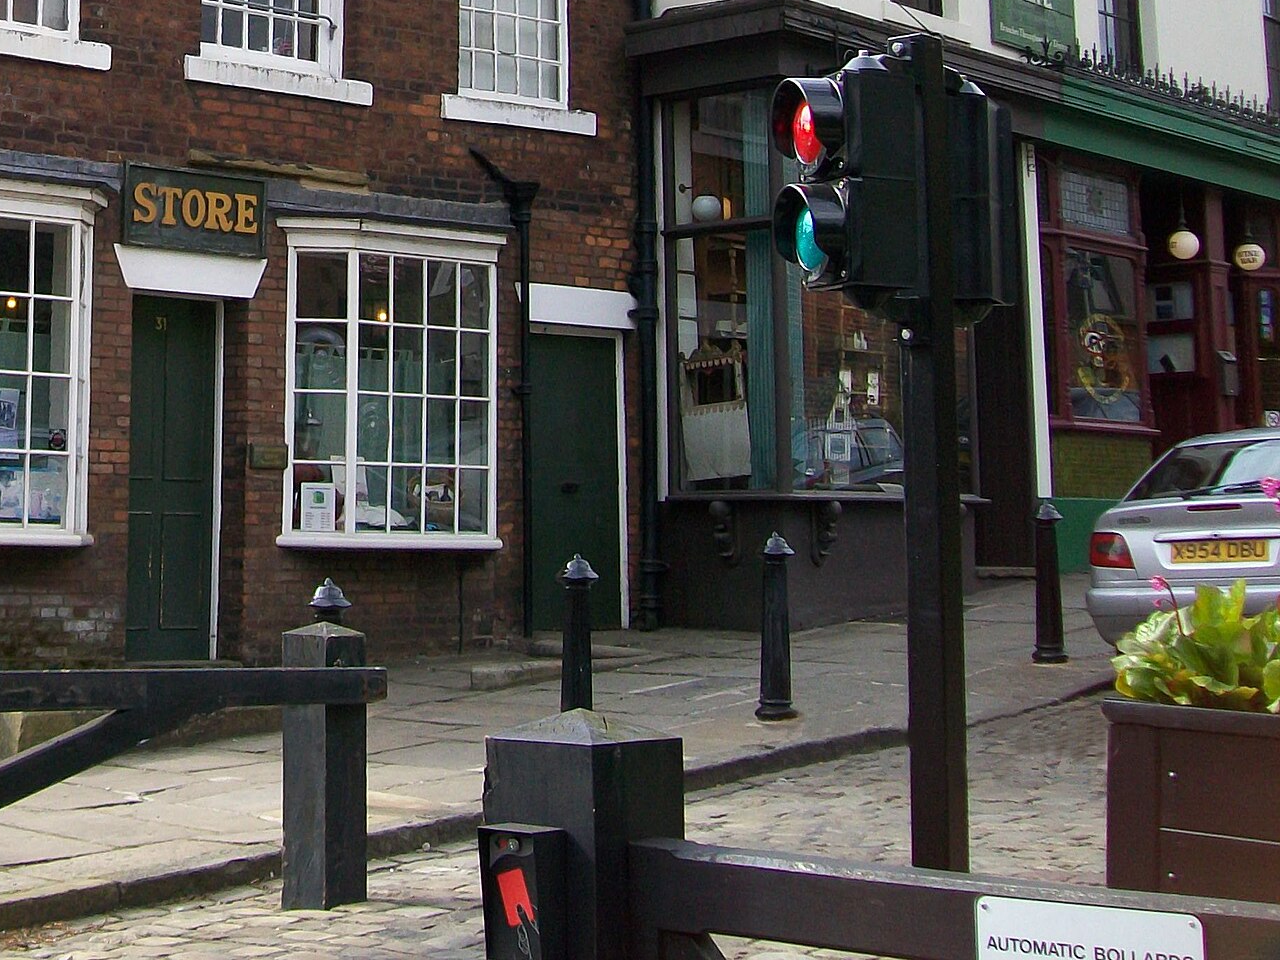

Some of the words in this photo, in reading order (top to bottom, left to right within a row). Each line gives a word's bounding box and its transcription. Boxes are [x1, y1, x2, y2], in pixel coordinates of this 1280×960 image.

[133, 182, 258, 234] STORE
[154, 317, 167, 331] 31
[1174, 542, 1220, 559] X954
[987, 935, 1086, 959] AUTOMATIC
[1094, 947, 1195, 960] BOLLA
